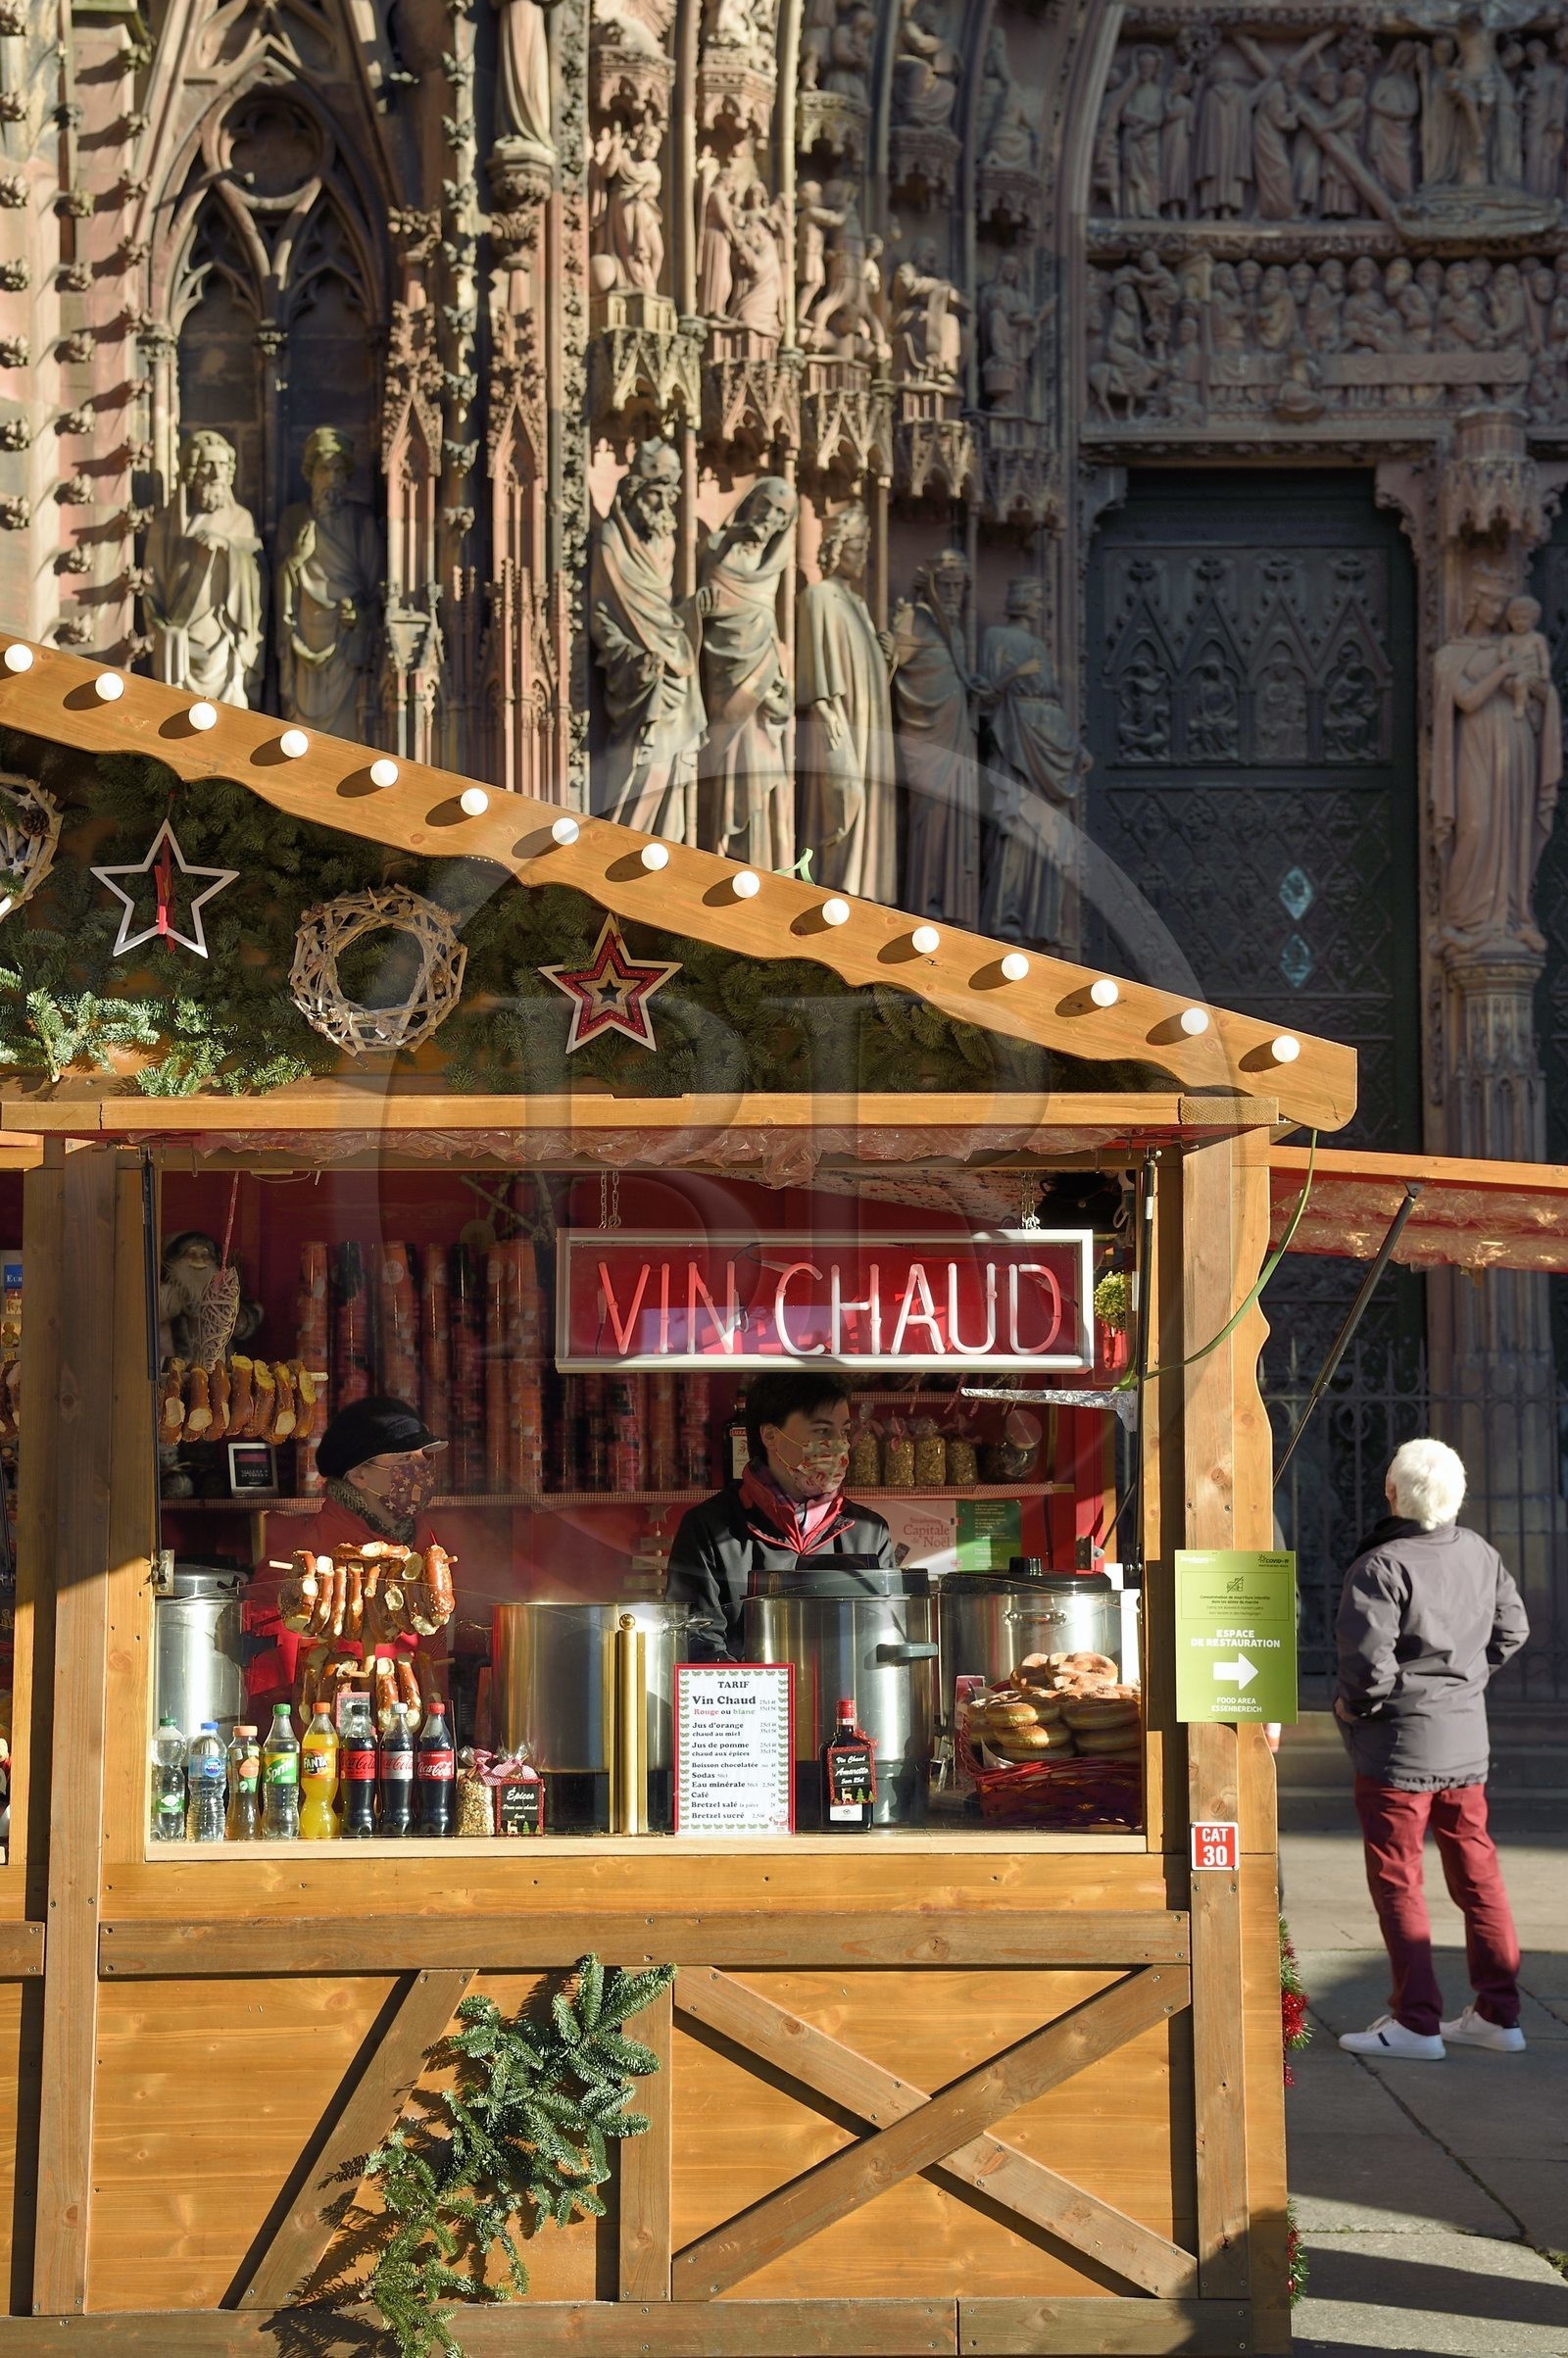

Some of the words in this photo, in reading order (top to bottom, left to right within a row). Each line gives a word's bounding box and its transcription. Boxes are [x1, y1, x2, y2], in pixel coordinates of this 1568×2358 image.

[598, 1260, 739, 1355] VIN
[774, 1262, 1061, 1355] CHAUD
[903, 1524, 950, 1538] Capitale
[923, 1537, 951, 1547] Noël
[1216, 1629, 1254, 1638] ESPACE
[1206, 1639, 1280, 1647] RESTAURATION
[692, 1695, 713, 1704] Vin
[717, 1695, 756, 1704] Chaud
[303, 1755, 327, 1769] FANTA
[417, 1761, 453, 1776] Coca-Cola
[507, 1787, 535, 1801] Épices
[1201, 1828, 1228, 1842] CAT
[1202, 1844, 1228, 1866] 30
